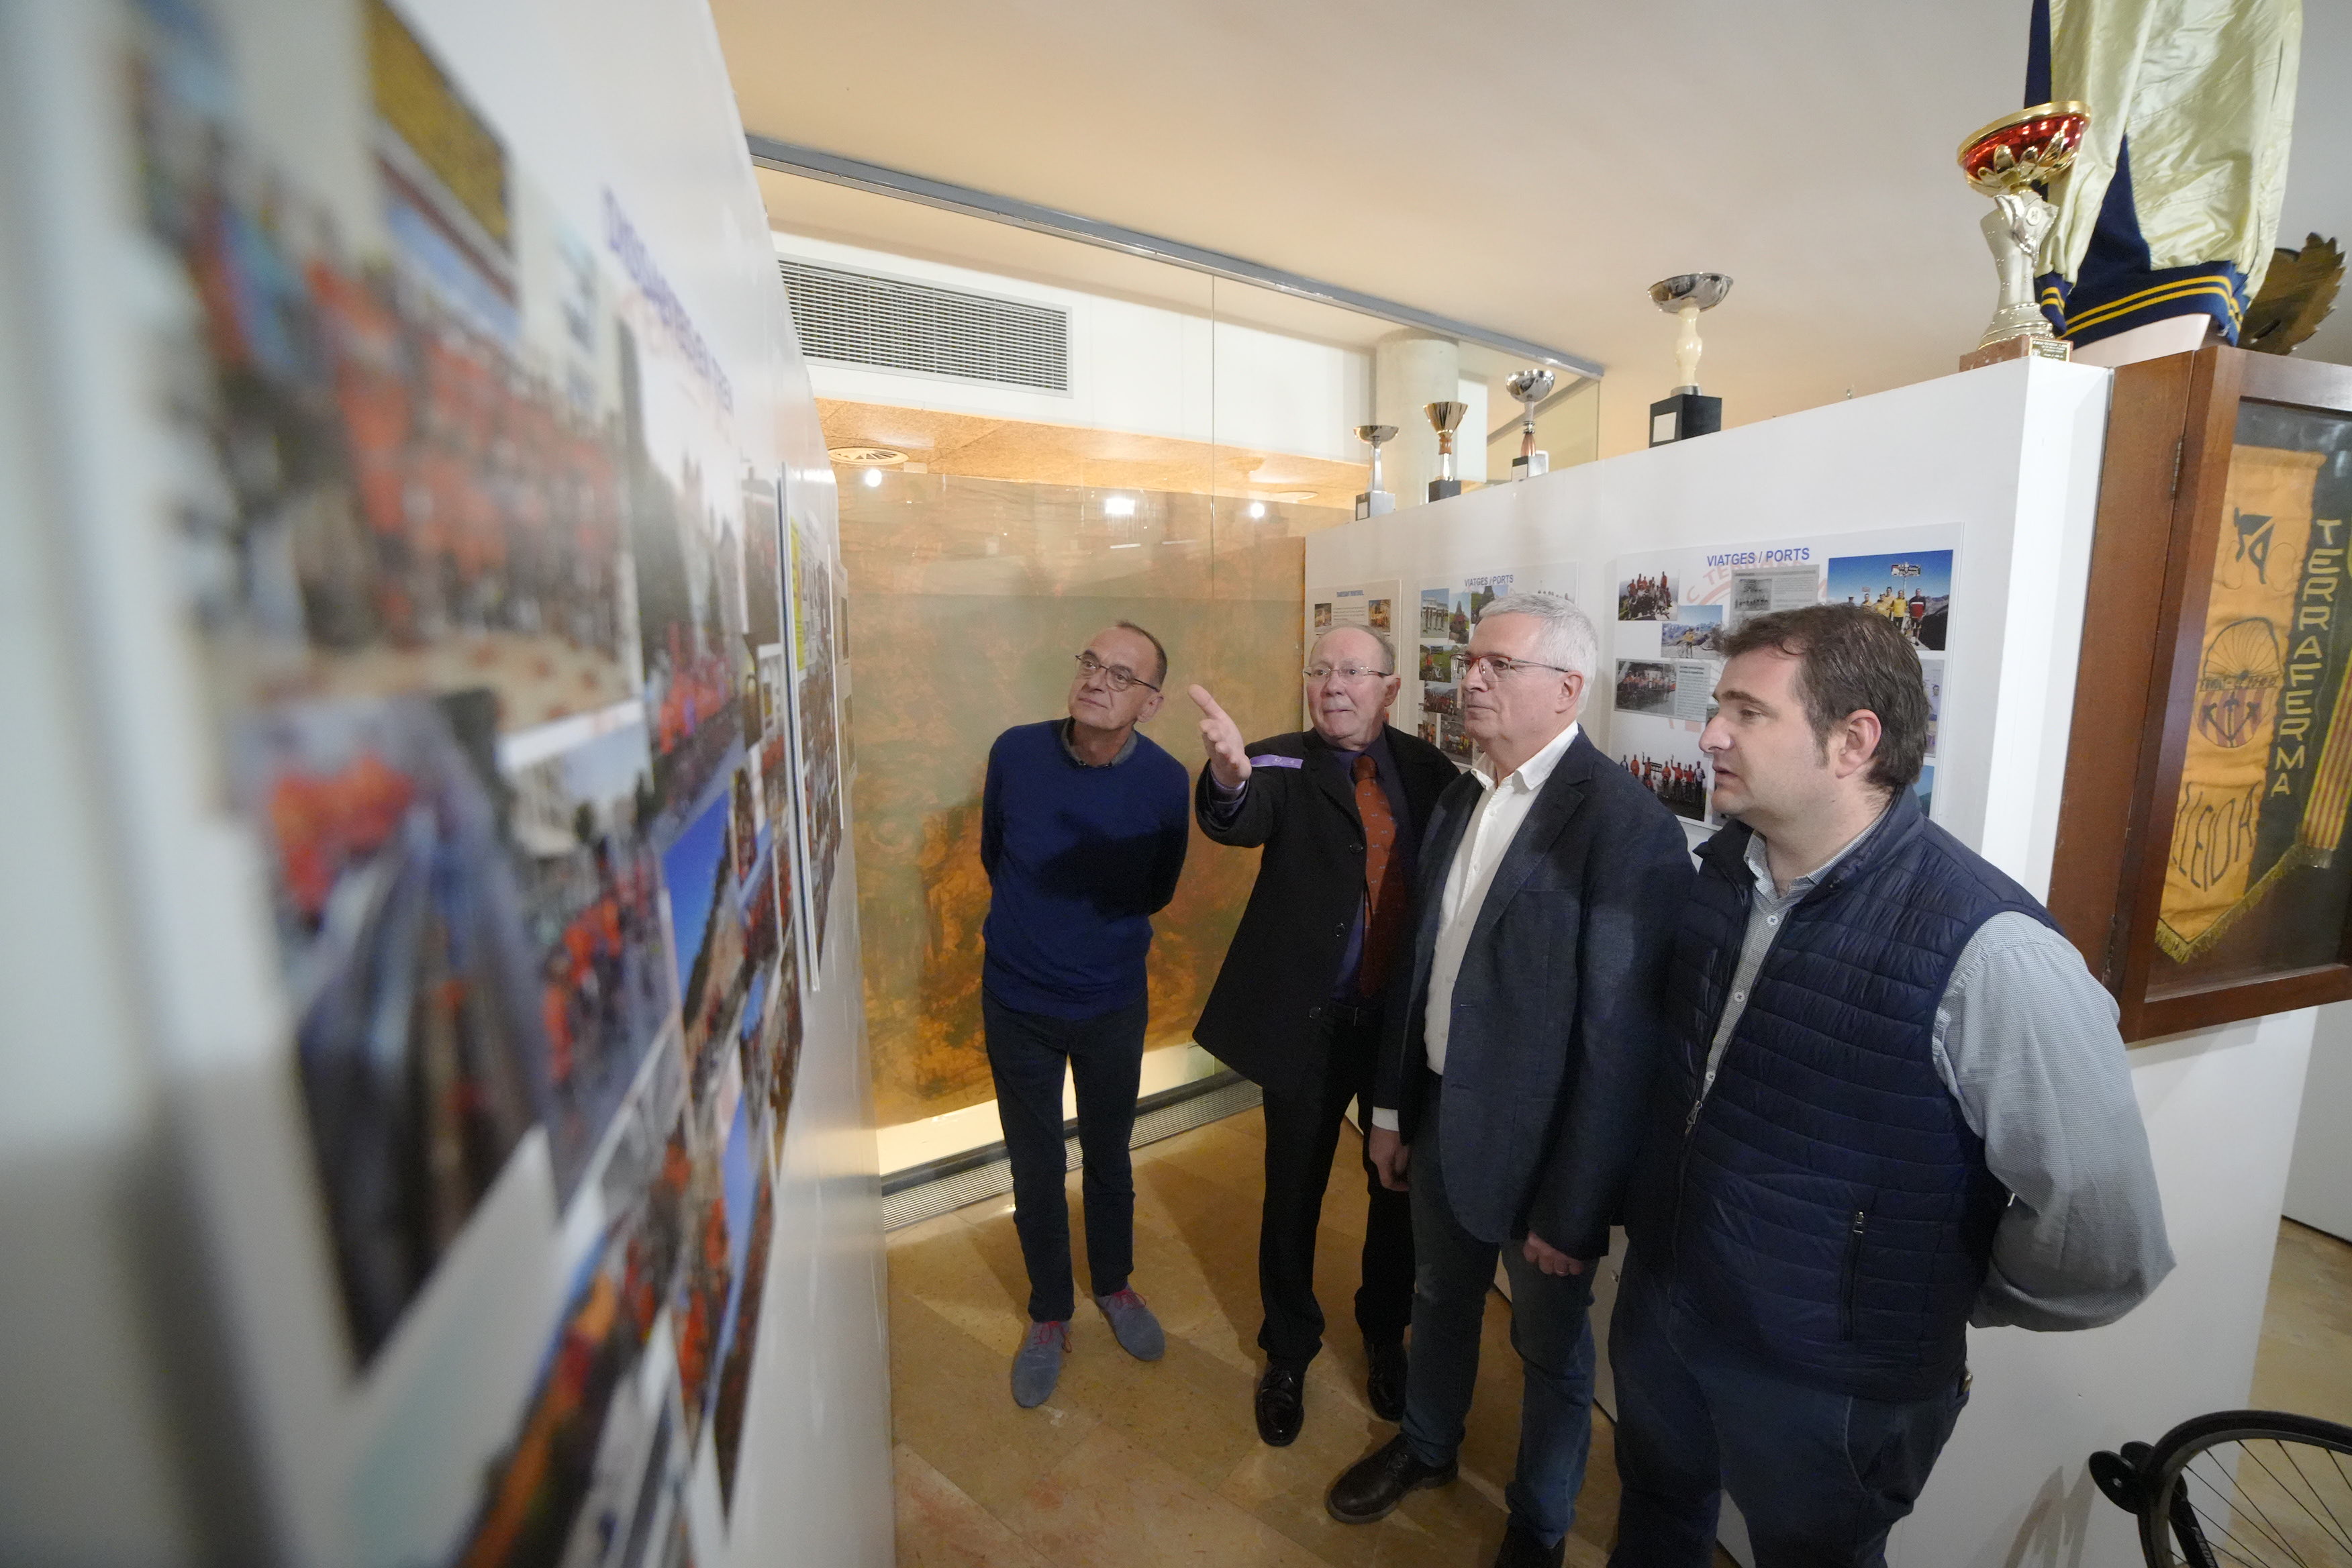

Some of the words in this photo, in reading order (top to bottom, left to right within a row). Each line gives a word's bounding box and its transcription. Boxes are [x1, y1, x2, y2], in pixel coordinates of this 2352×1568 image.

[1707, 552, 1755, 567] VIATGES
[1766, 548, 1810, 562] PORTS
[1465, 577, 1488, 587] VIATGES
[1493, 575, 1514, 585] PORTS
